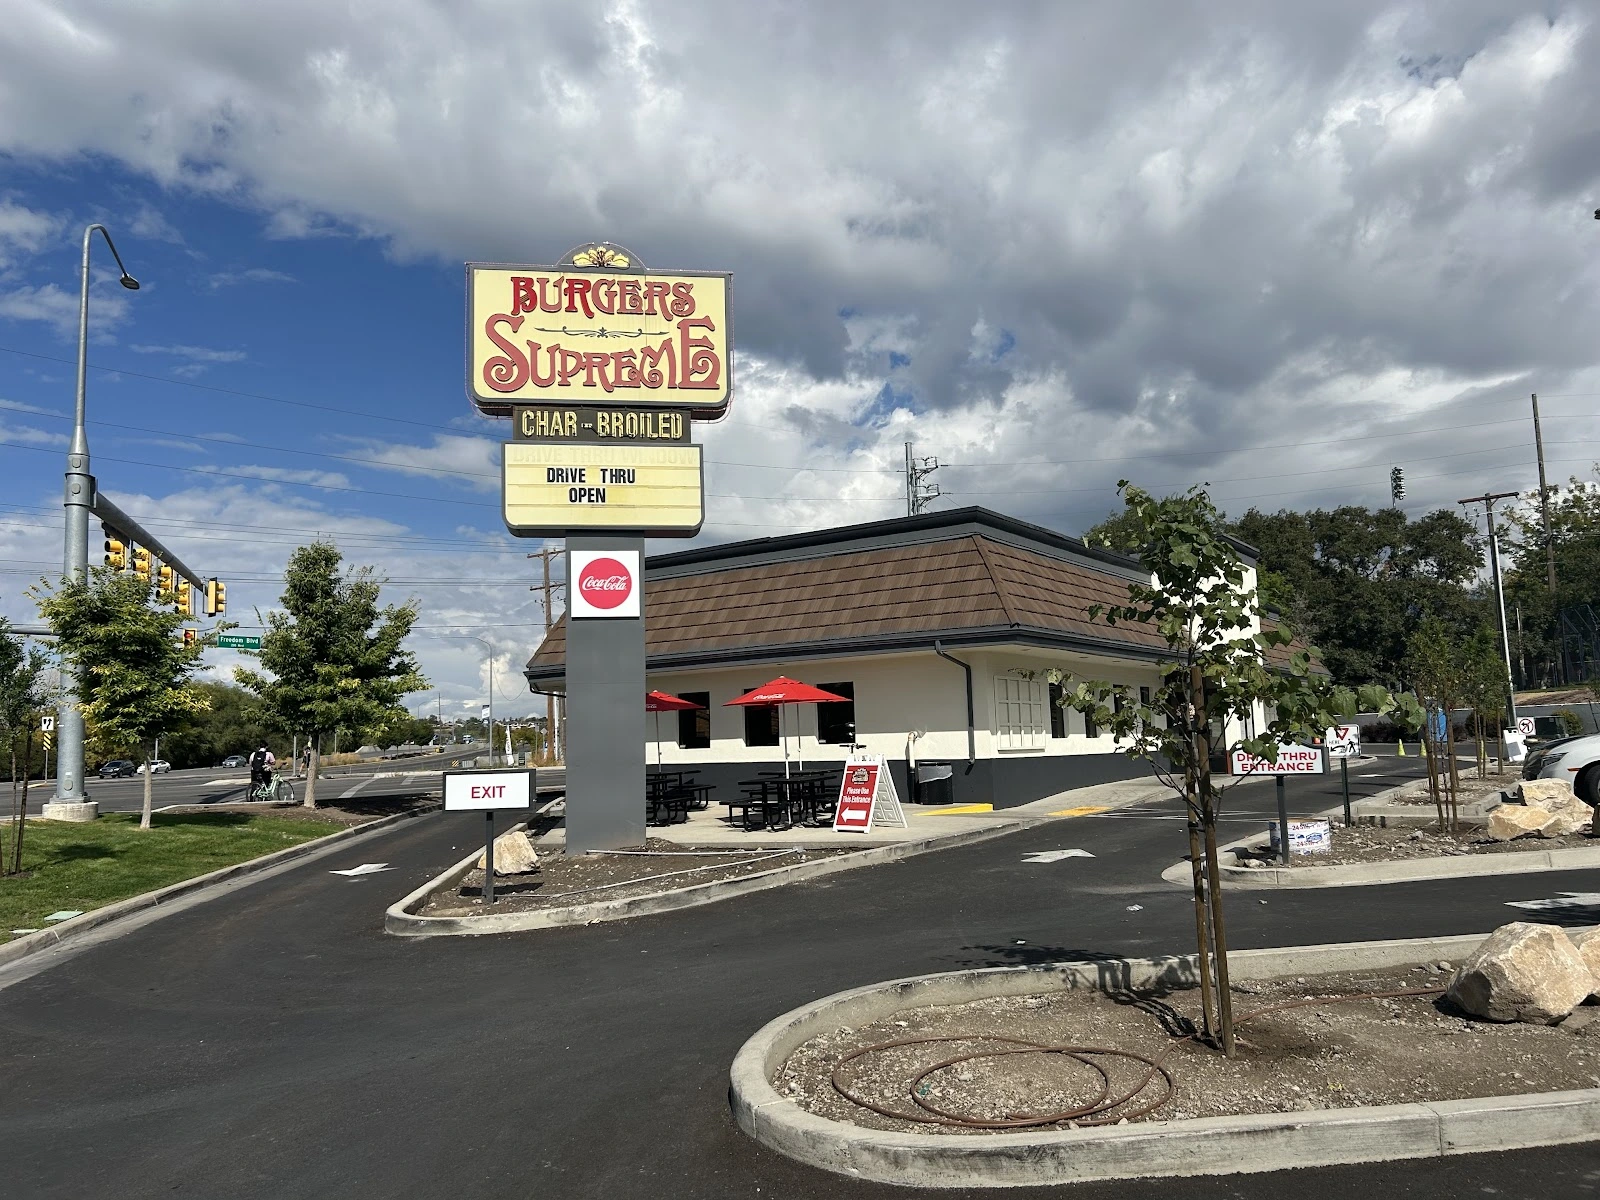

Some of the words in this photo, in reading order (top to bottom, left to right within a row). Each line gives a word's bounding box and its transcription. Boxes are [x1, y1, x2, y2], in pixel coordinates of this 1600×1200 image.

[510, 276, 696, 321] BURGERS
[483, 313, 720, 392] SUPREME
[546, 467, 586, 483] DRIVE
[600, 468, 636, 484] THRU
[568, 487, 606, 503] OPEN
[582, 575, 629, 591] Coca-Cola
[1281, 752, 1317, 760] THRU
[1241, 762, 1314, 772] ENTRANCE
[471, 785, 506, 799] EXIT
